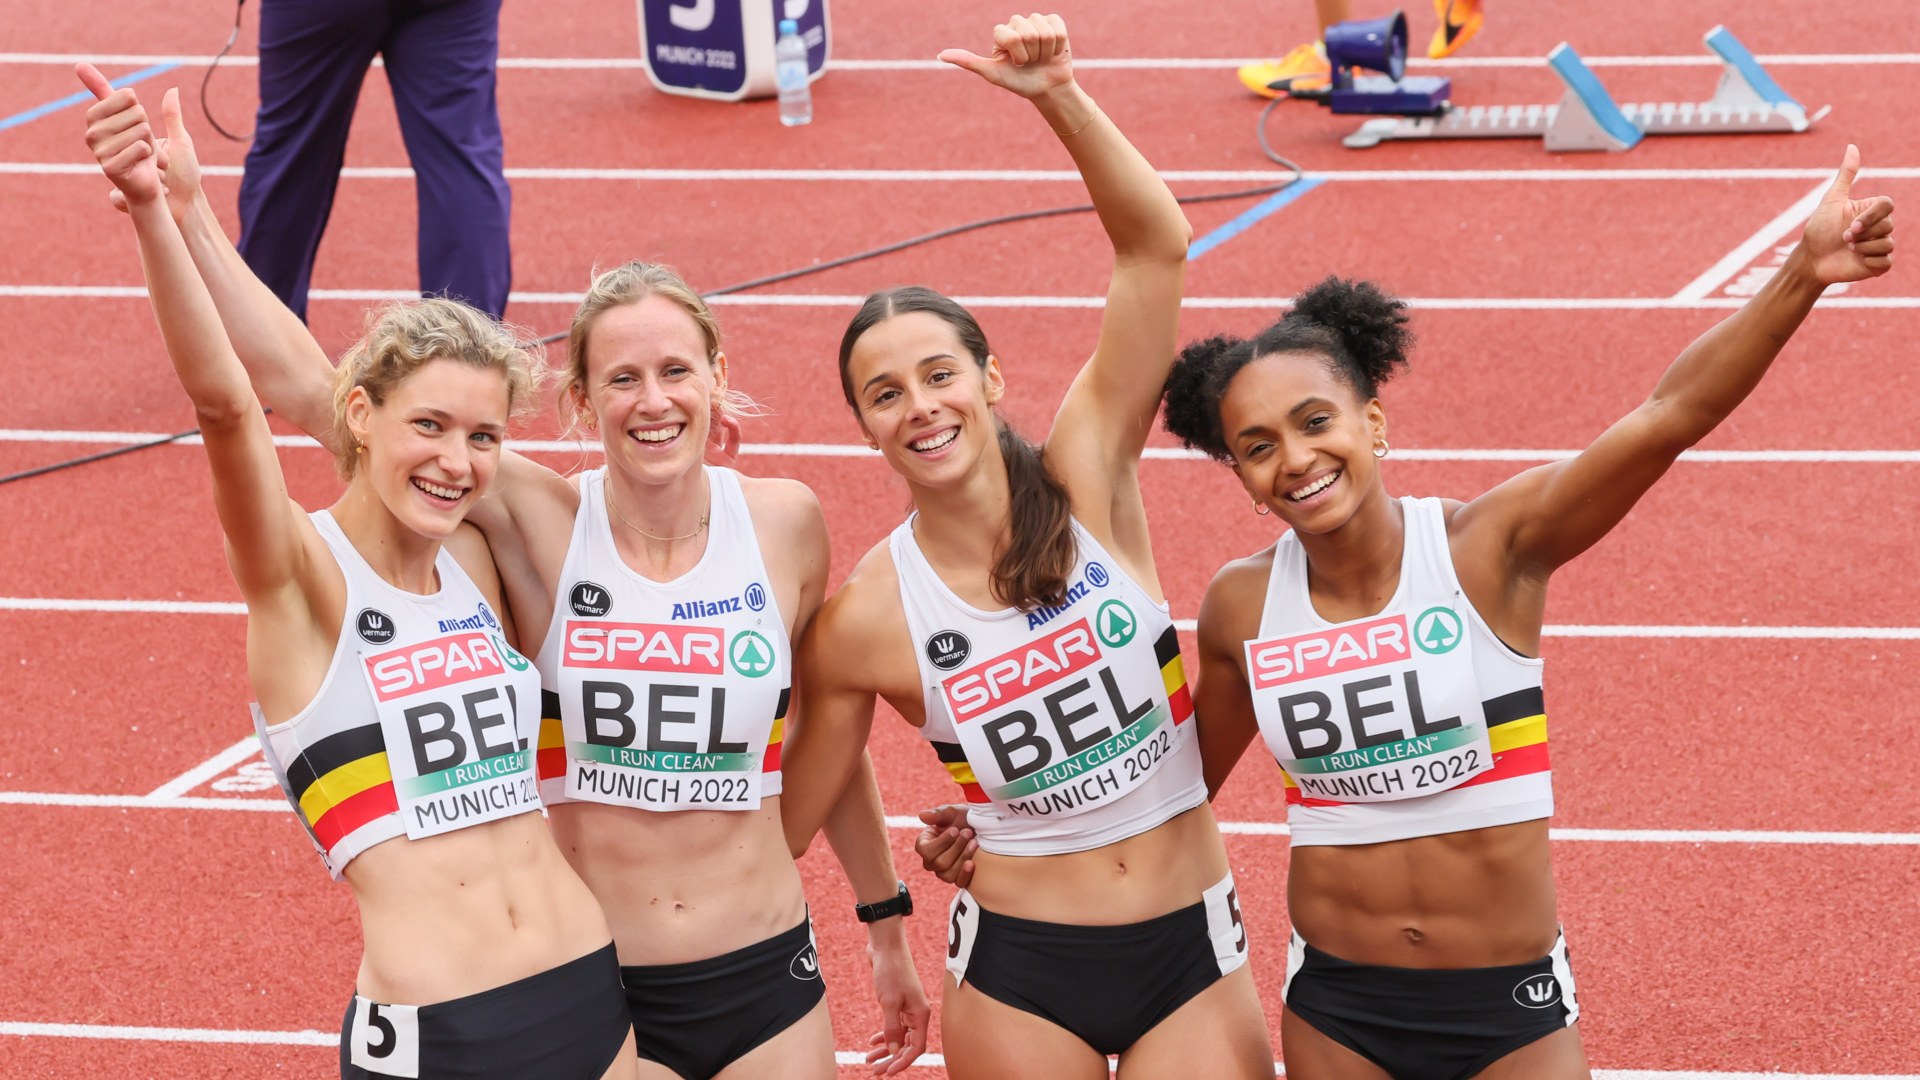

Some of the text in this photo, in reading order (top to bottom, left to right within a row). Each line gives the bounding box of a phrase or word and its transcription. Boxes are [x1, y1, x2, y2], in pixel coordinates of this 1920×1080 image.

[437, 614, 485, 633] Allianz
[573, 602, 604, 615] vermarc
[671, 596, 742, 620] Allianz
[362, 629, 391, 637] vermarc
[568, 628, 720, 668] SPAR
[1256, 622, 1406, 681] SPAR
[373, 638, 499, 693] SPAR
[934, 649, 965, 664] vermarc
[951, 628, 1095, 714] SPAR
[582, 680, 749, 754] BEL
[981, 665, 1155, 783] BEL
[1278, 670, 1462, 760] BEL
[444, 771, 452, 787] I
[456, 762, 492, 785] RUN
[610, 748, 616, 763] I
[621, 749, 656, 769] RUN
[1007, 730, 1171, 816] MUNICH 2022
[1033, 776, 1041, 790] I
[1043, 758, 1083, 786] RUN
[1300, 749, 1480, 797] MUNICH 2022
[1321, 758, 1328, 772] I
[1330, 751, 1370, 770] RUN
[415, 781, 517, 829] MUNICH
[578, 767, 749, 803] MUNICH 2022
[367, 1003, 397, 1059] 5
